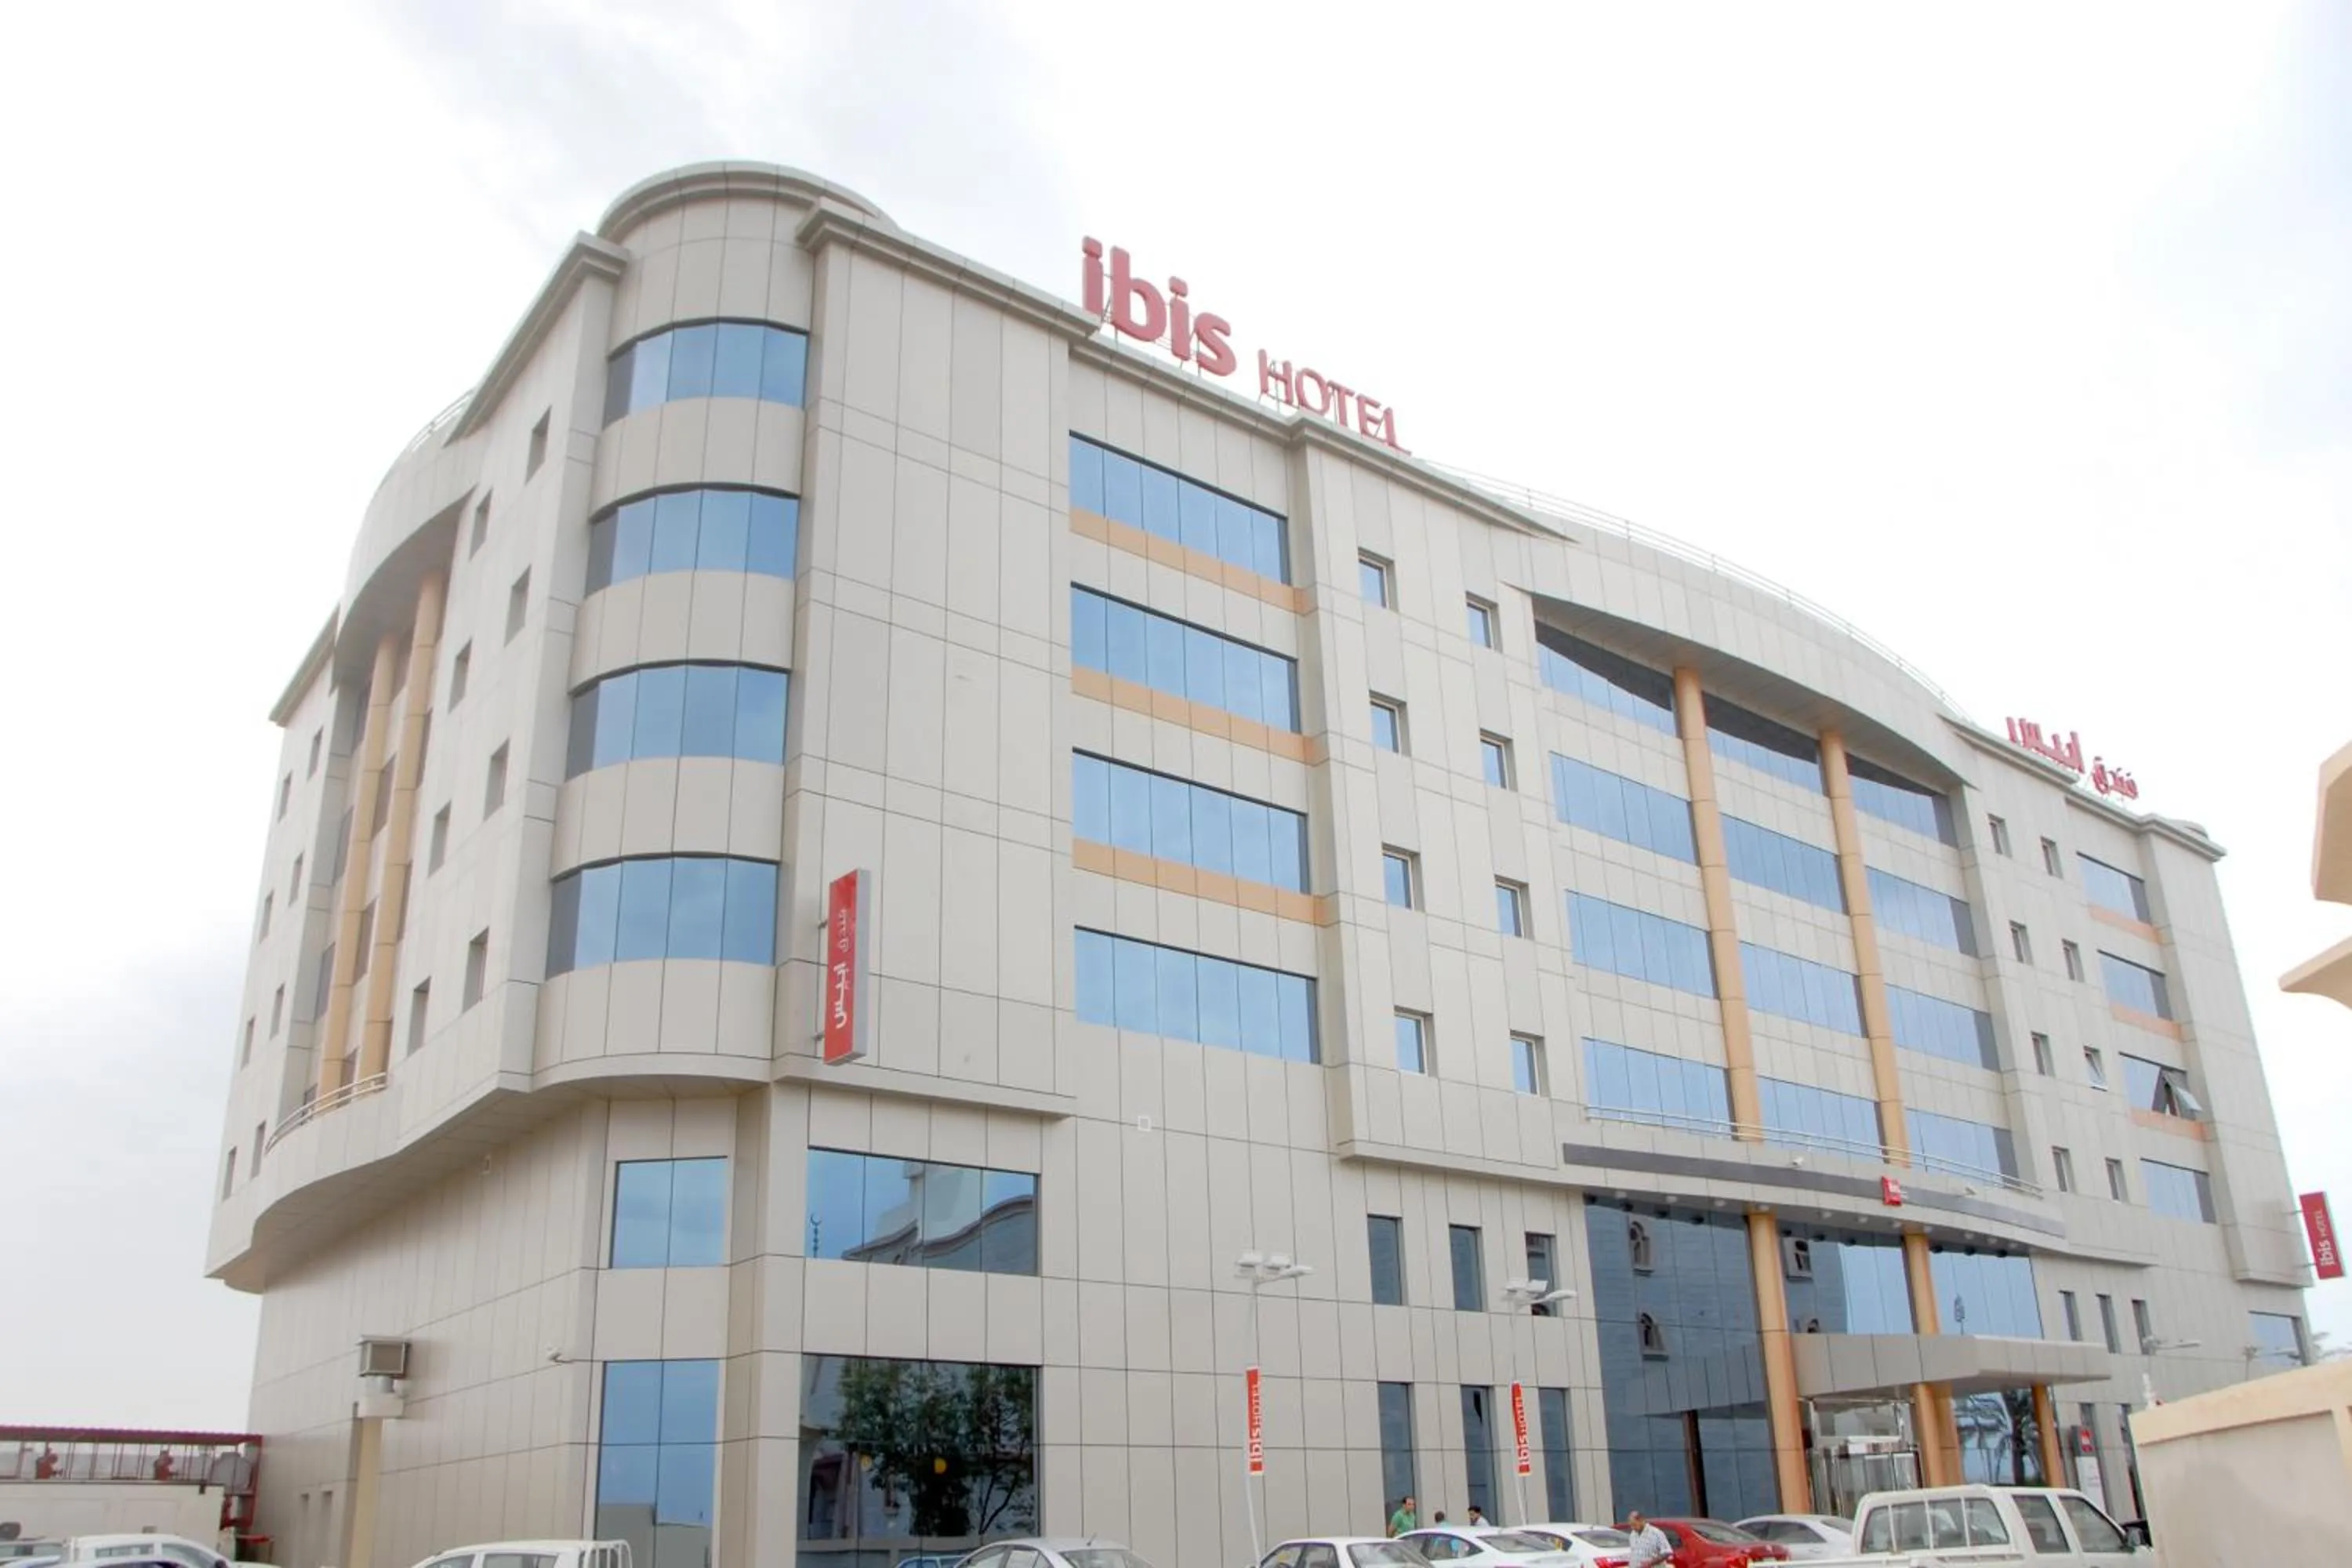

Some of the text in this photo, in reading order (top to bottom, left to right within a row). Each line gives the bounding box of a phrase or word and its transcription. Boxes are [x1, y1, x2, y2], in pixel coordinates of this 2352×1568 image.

[1083, 235, 1412, 456] ibis HOTEL
[2318, 1239, 2334, 1265] ibis
[1250, 1428, 1262, 1461] ibis
[1518, 1434, 1530, 1465] ibis
